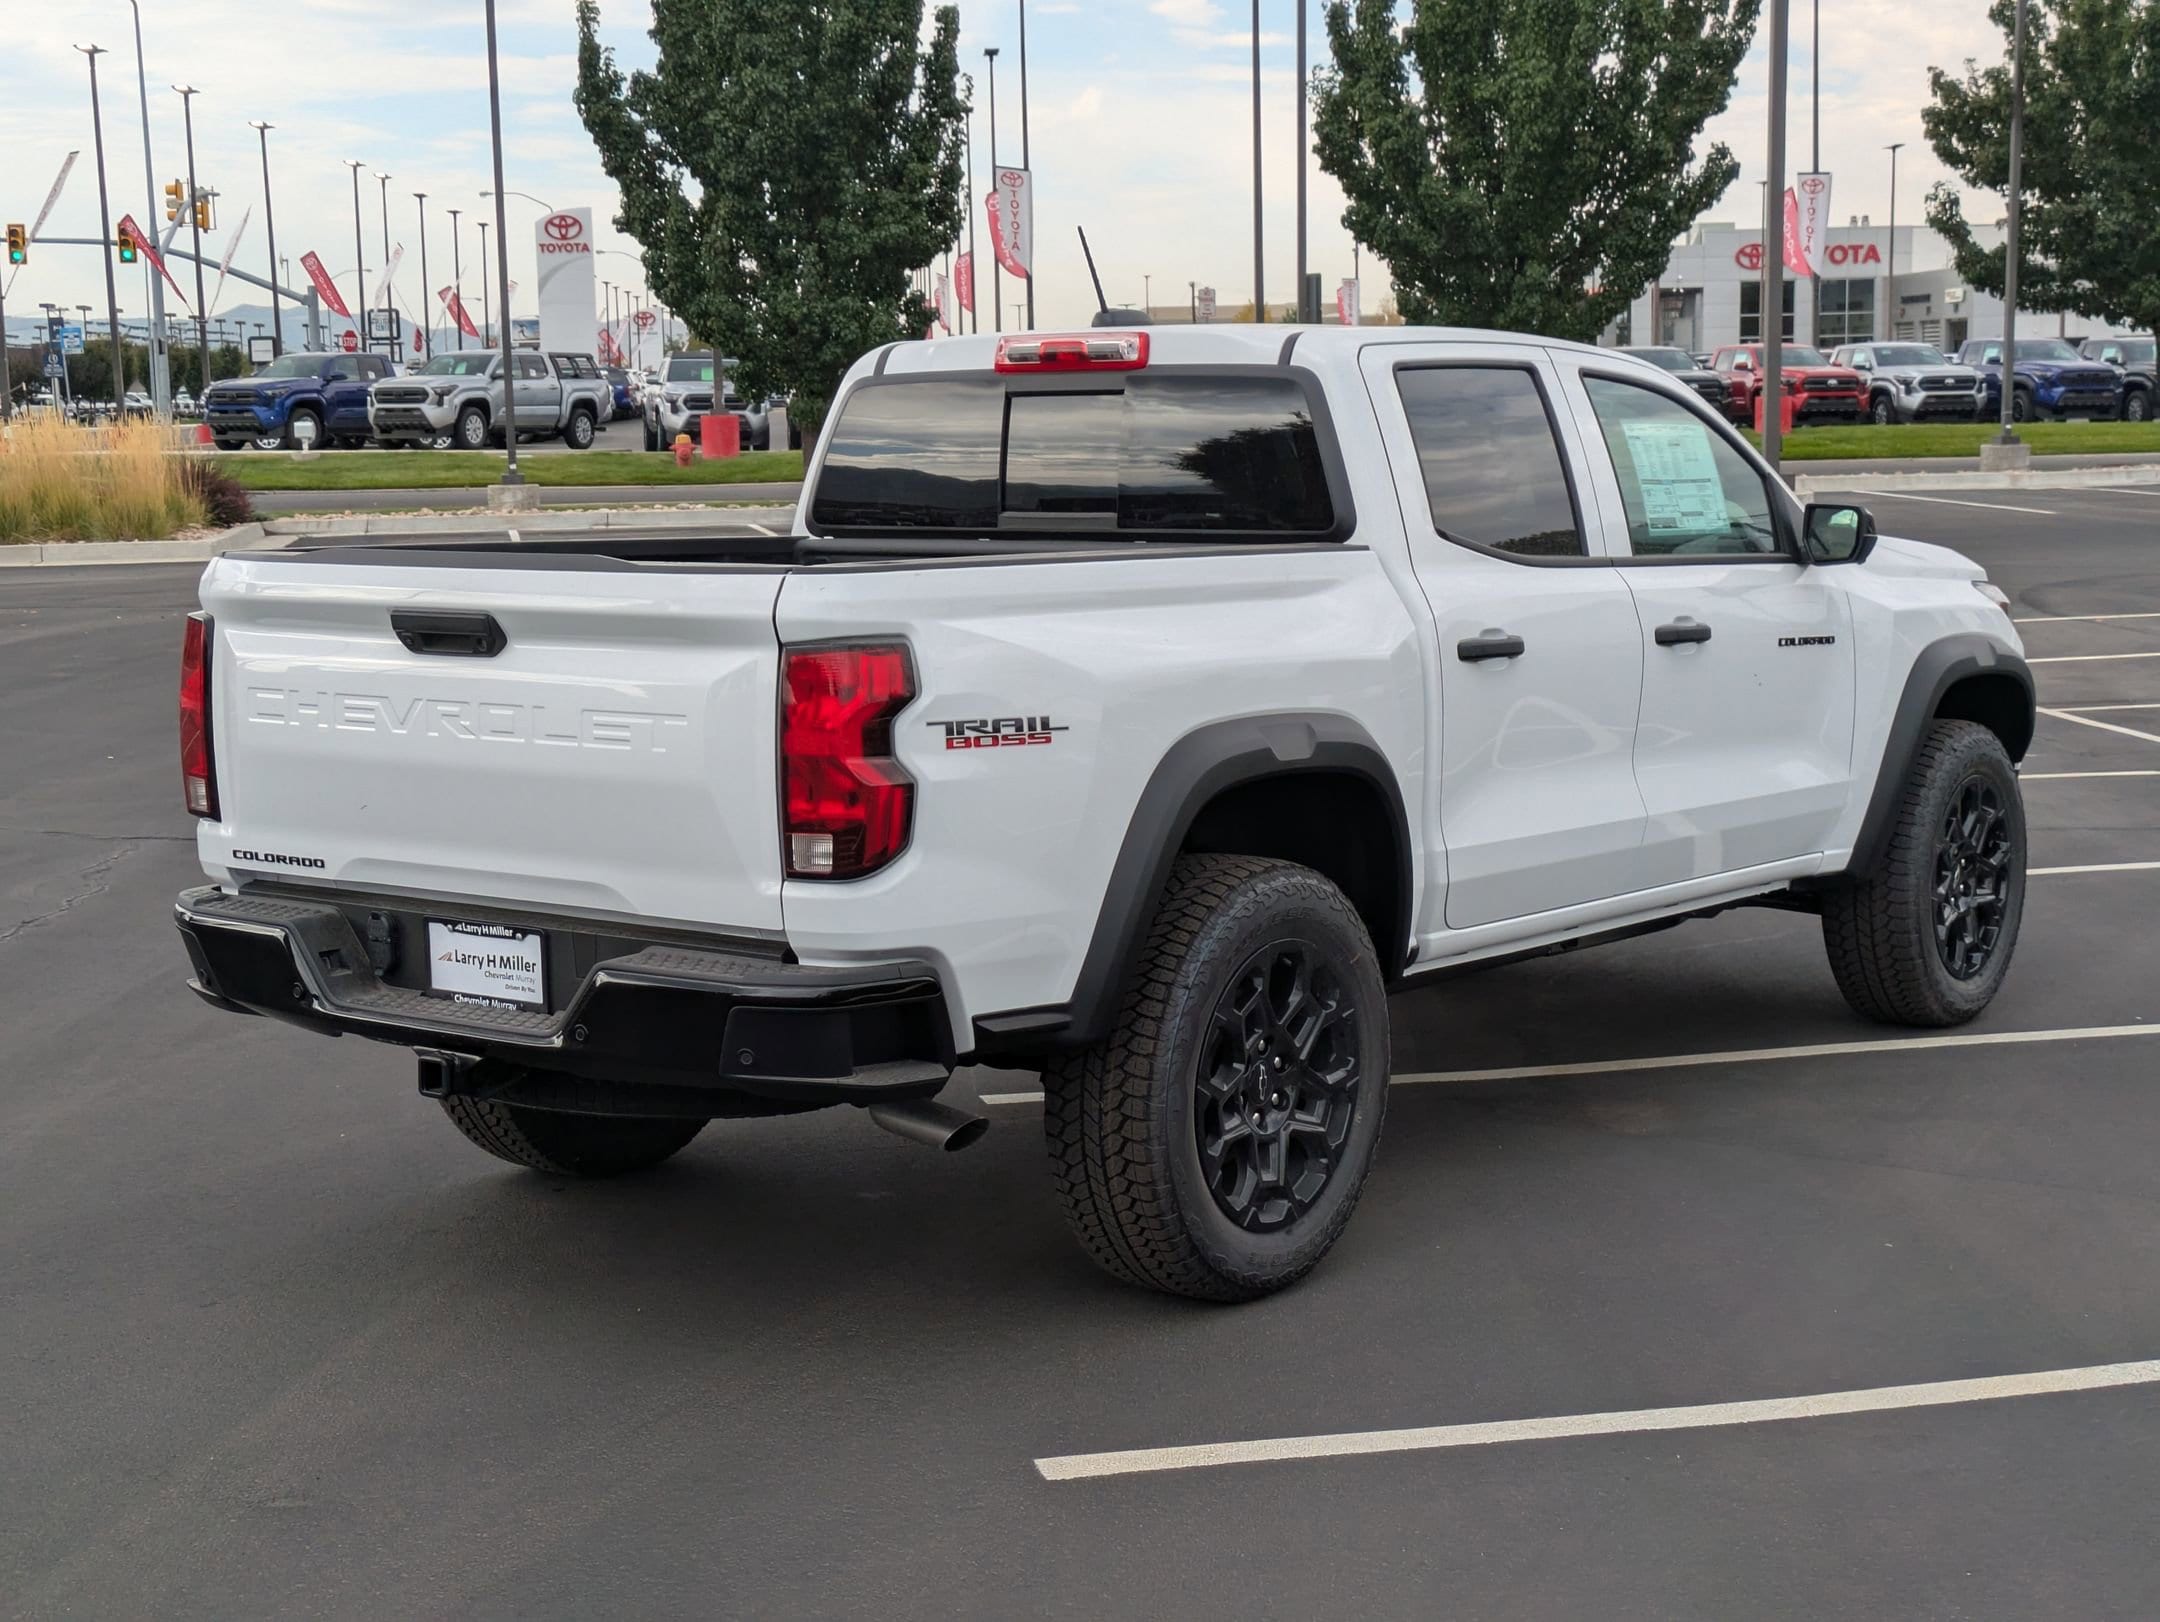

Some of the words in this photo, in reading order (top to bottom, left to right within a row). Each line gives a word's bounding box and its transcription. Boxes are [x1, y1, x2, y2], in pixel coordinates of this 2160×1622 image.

[1010, 190, 1020, 250] TOYOTA
[1804, 197, 1816, 254] TOYOTA
[539, 243, 590, 254] TOYOTA
[343, 336, 357, 347] STOP
[1777, 635, 1836, 647] COLORADO
[248, 687, 687, 753] CHEVROLET
[926, 715, 1069, 737] TRAIL
[946, 731, 1052, 750] BOSS
[232, 849, 325, 869] COLORADO
[462, 922, 482, 936] Larry
[482, 924, 489, 935] H
[489, 924, 514, 938] Miller
[455, 949, 485, 970] Larry
[487, 954, 496, 968] H
[499, 955, 537, 973] Miller
[484, 970, 514, 982] Chevrolet
[515, 972, 536, 985] Murray
[454, 994, 490, 1007] Chevrolet
[491, 1000, 517, 1011] Murray
